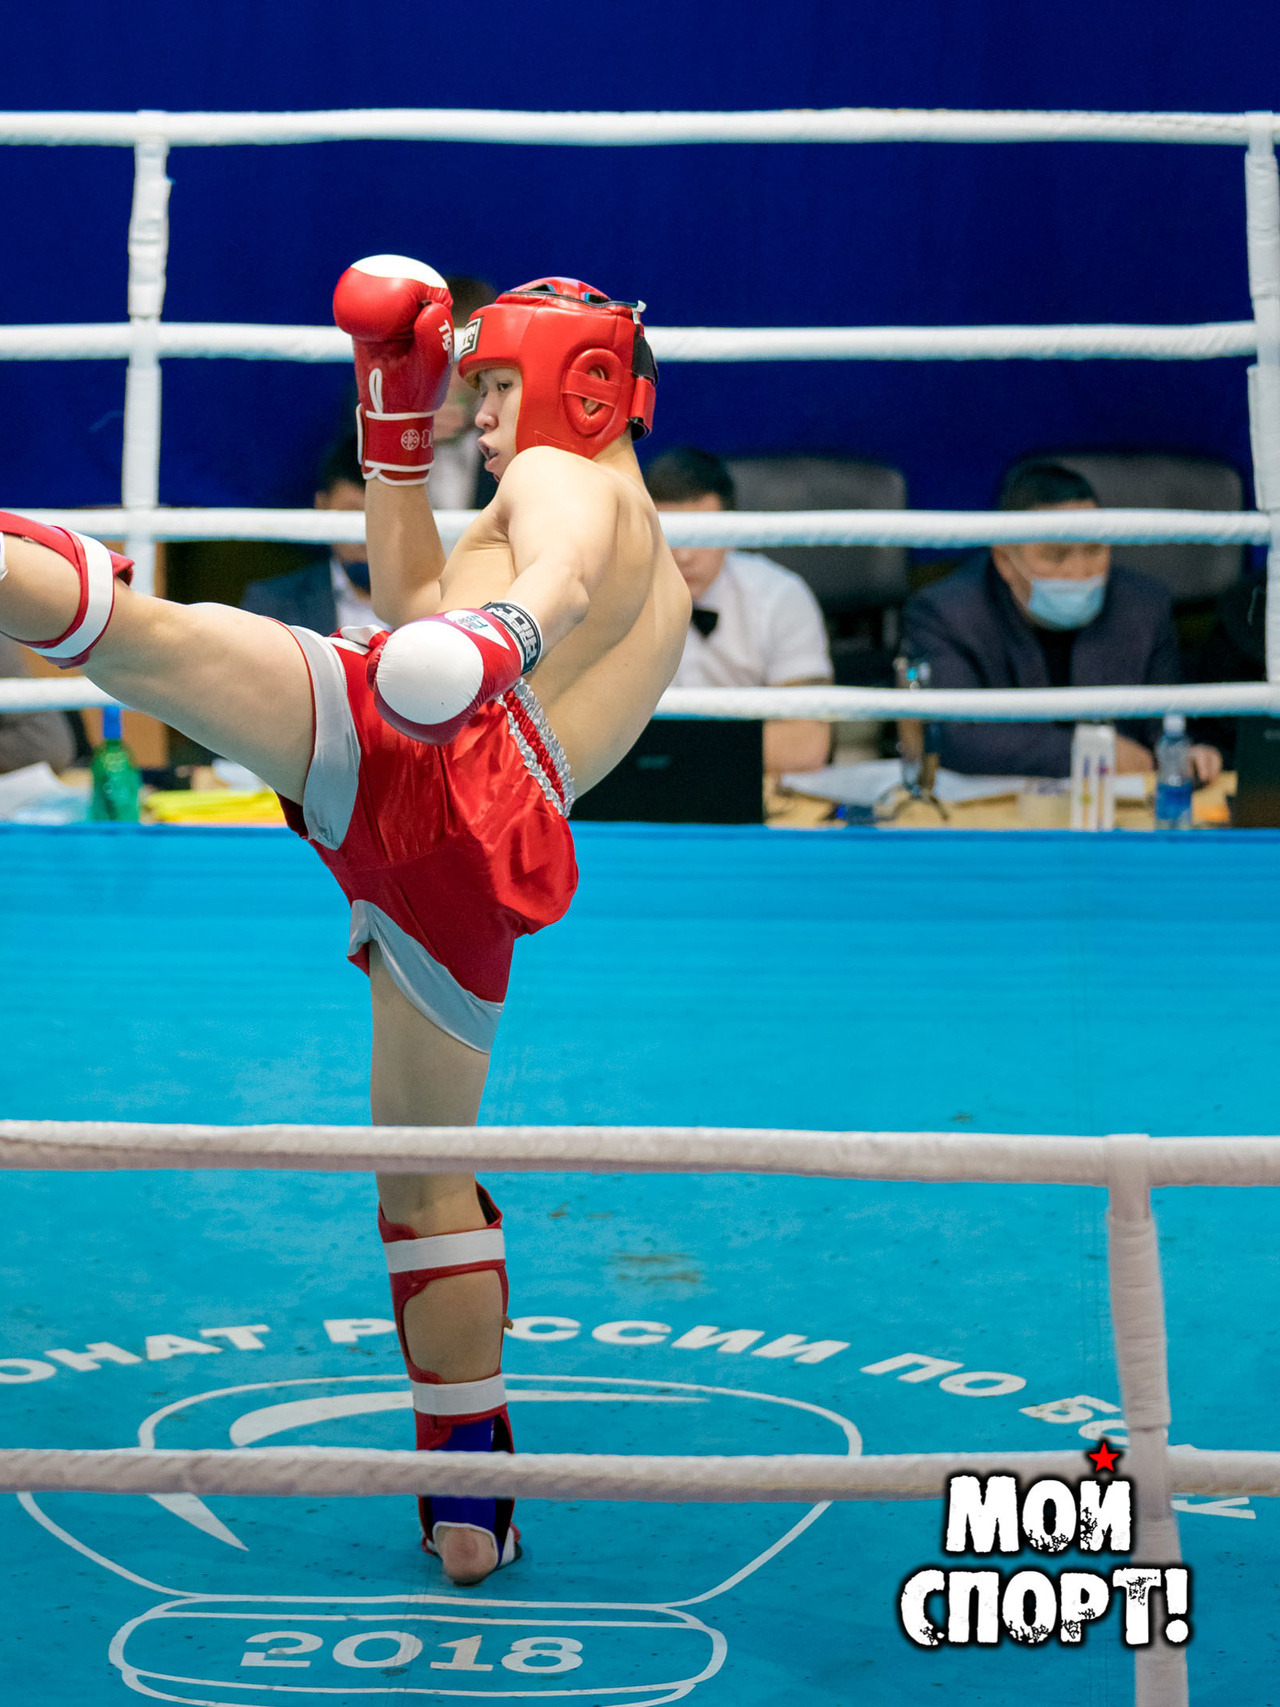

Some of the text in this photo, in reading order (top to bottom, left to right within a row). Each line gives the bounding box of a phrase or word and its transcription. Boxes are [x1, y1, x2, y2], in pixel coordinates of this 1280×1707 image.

[323, 1315, 851, 1364] РССИИ
[859, 1352, 1027, 1397] ПО
[240, 1630, 583, 1674] 2018
